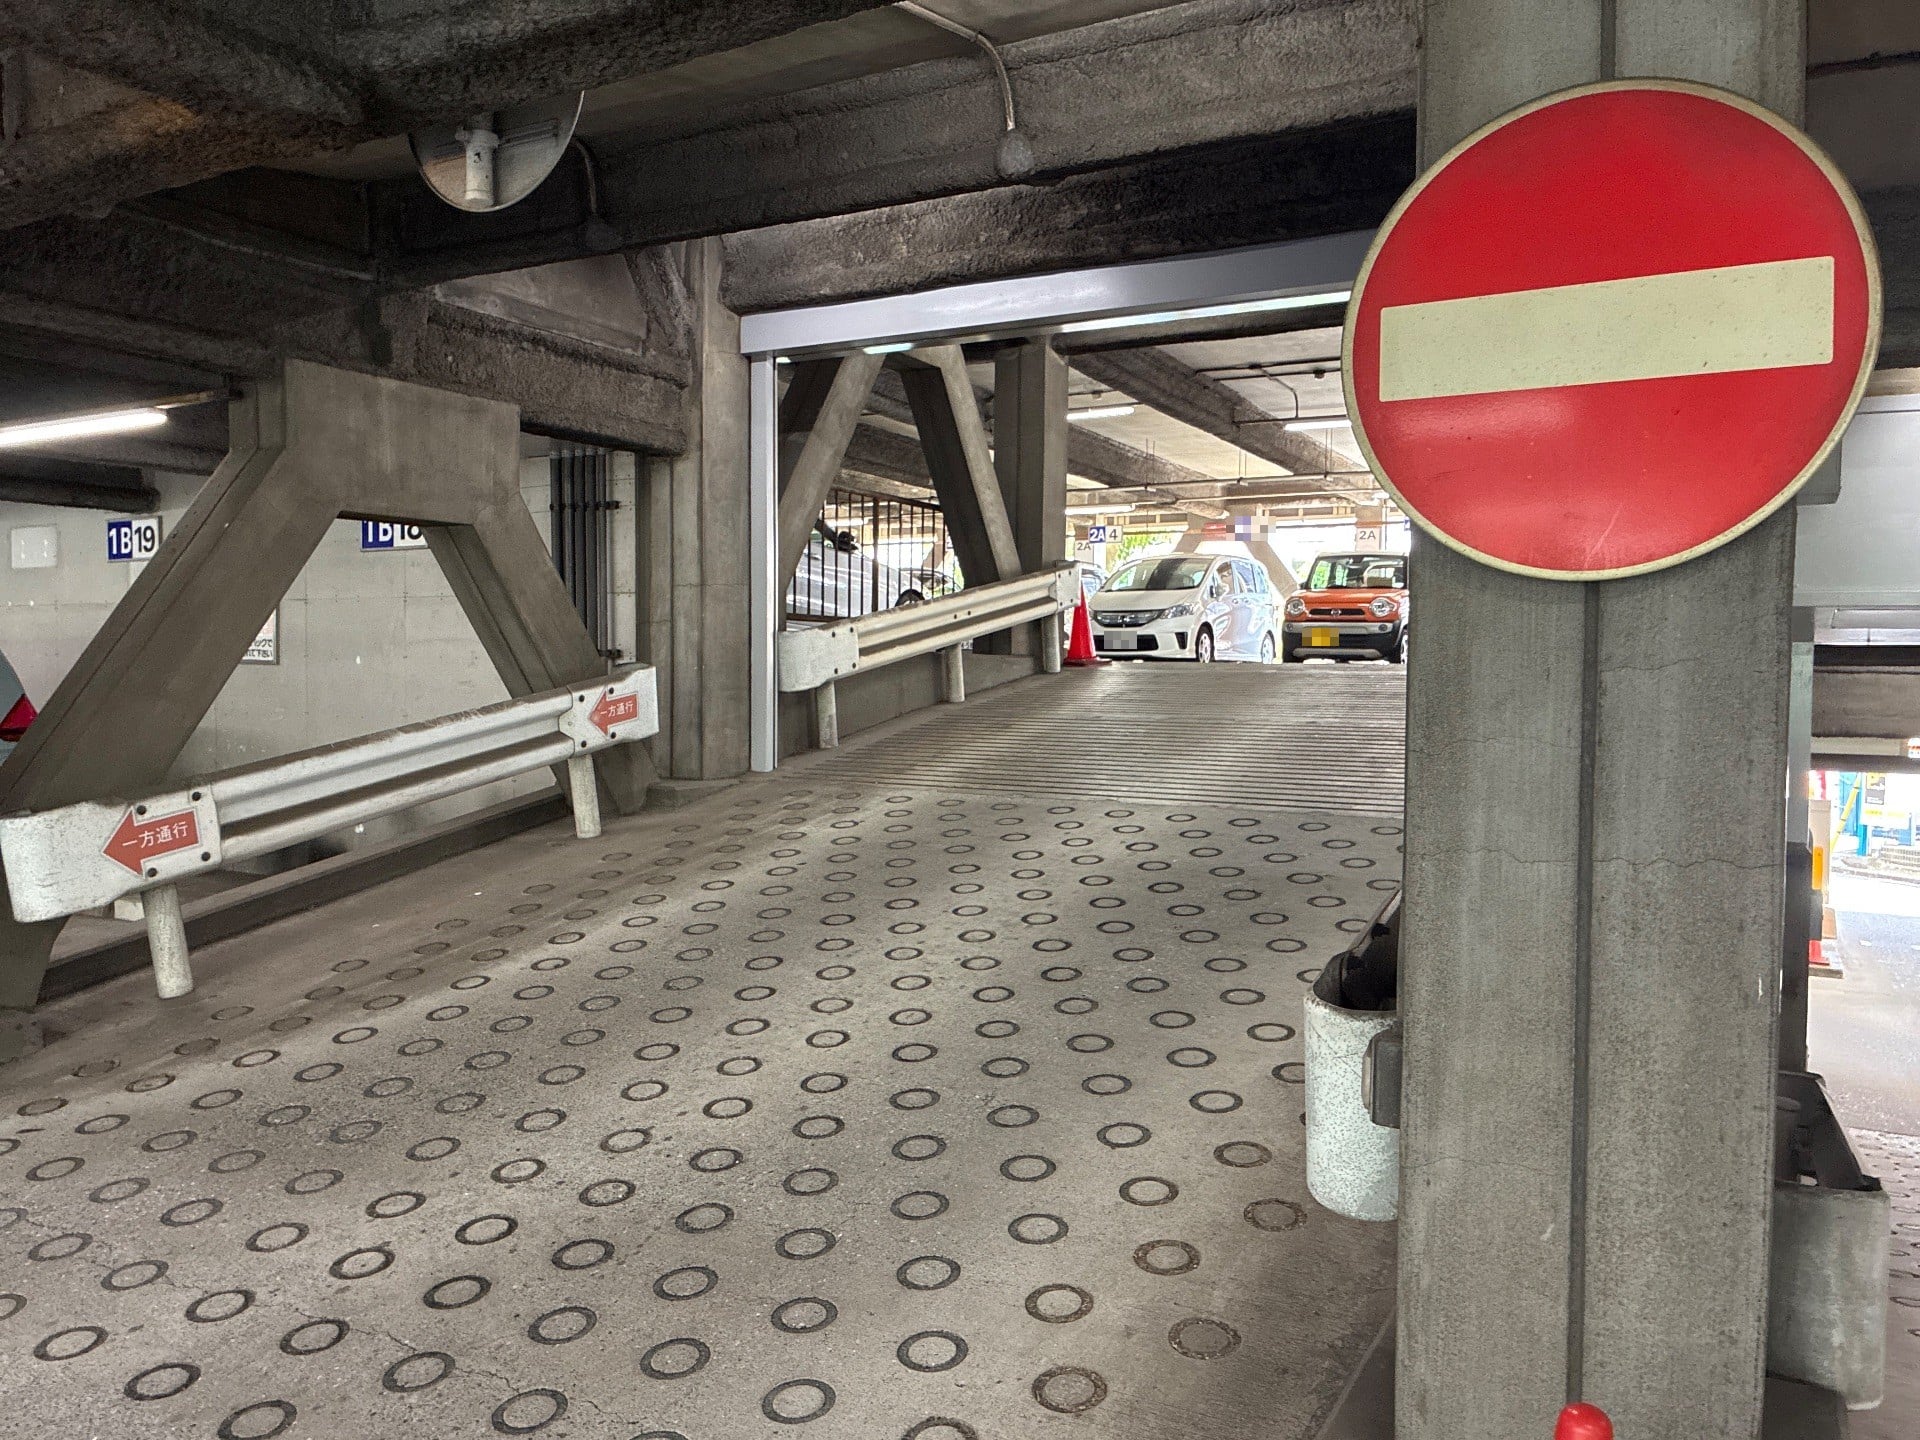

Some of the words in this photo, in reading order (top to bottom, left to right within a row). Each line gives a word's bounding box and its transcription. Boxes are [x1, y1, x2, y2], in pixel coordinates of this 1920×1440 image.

[1361, 530, 1376, 540] 2A
[1077, 542, 1091, 550] 2A
[600, 700, 634, 717] 一方通行
[122, 821, 188, 848] 一方通行
